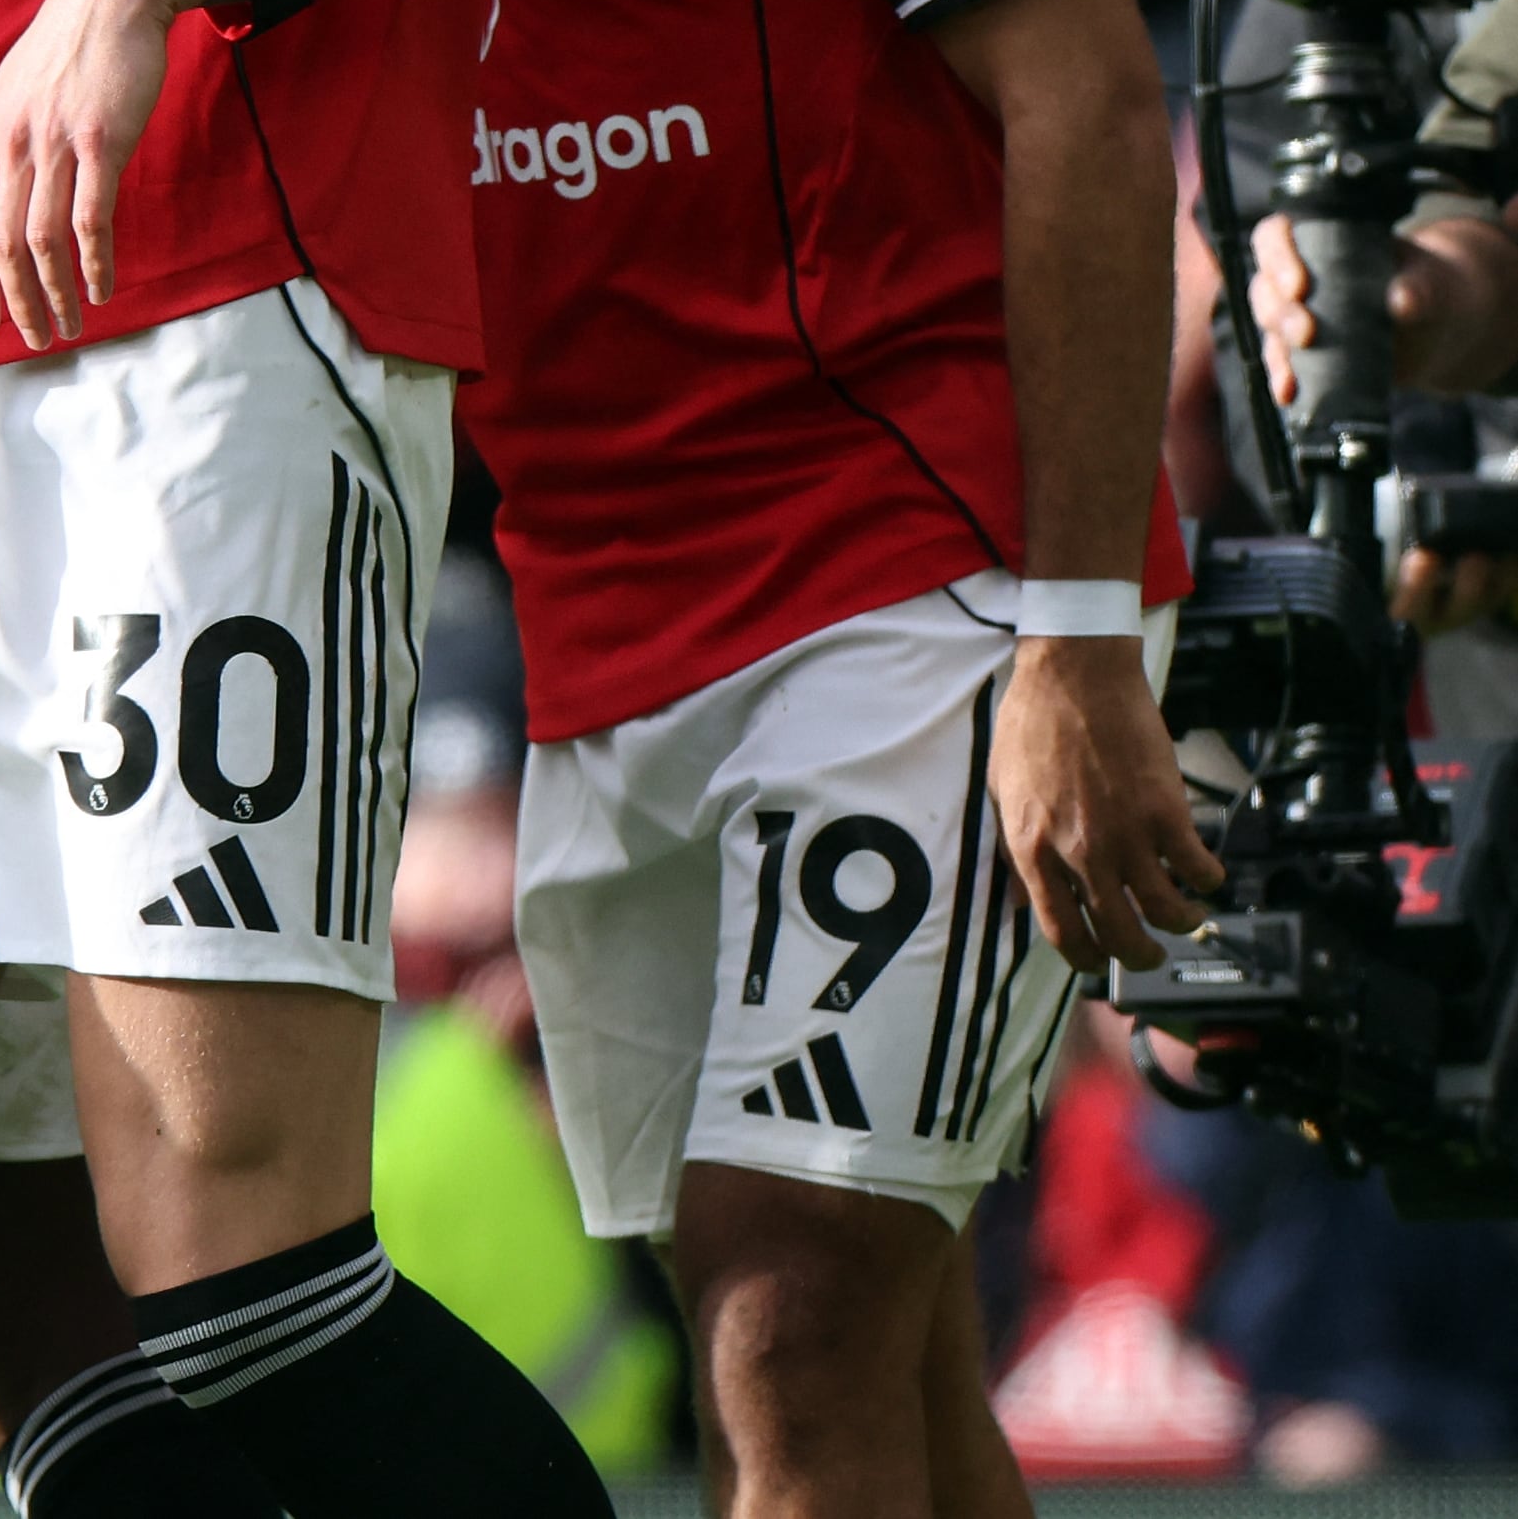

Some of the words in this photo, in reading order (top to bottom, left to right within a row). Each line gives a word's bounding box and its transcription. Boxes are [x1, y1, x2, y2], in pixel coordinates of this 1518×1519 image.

[470, 104, 711, 200] dragon
[57, 613, 311, 825] 30
[741, 810, 934, 1014] 19
